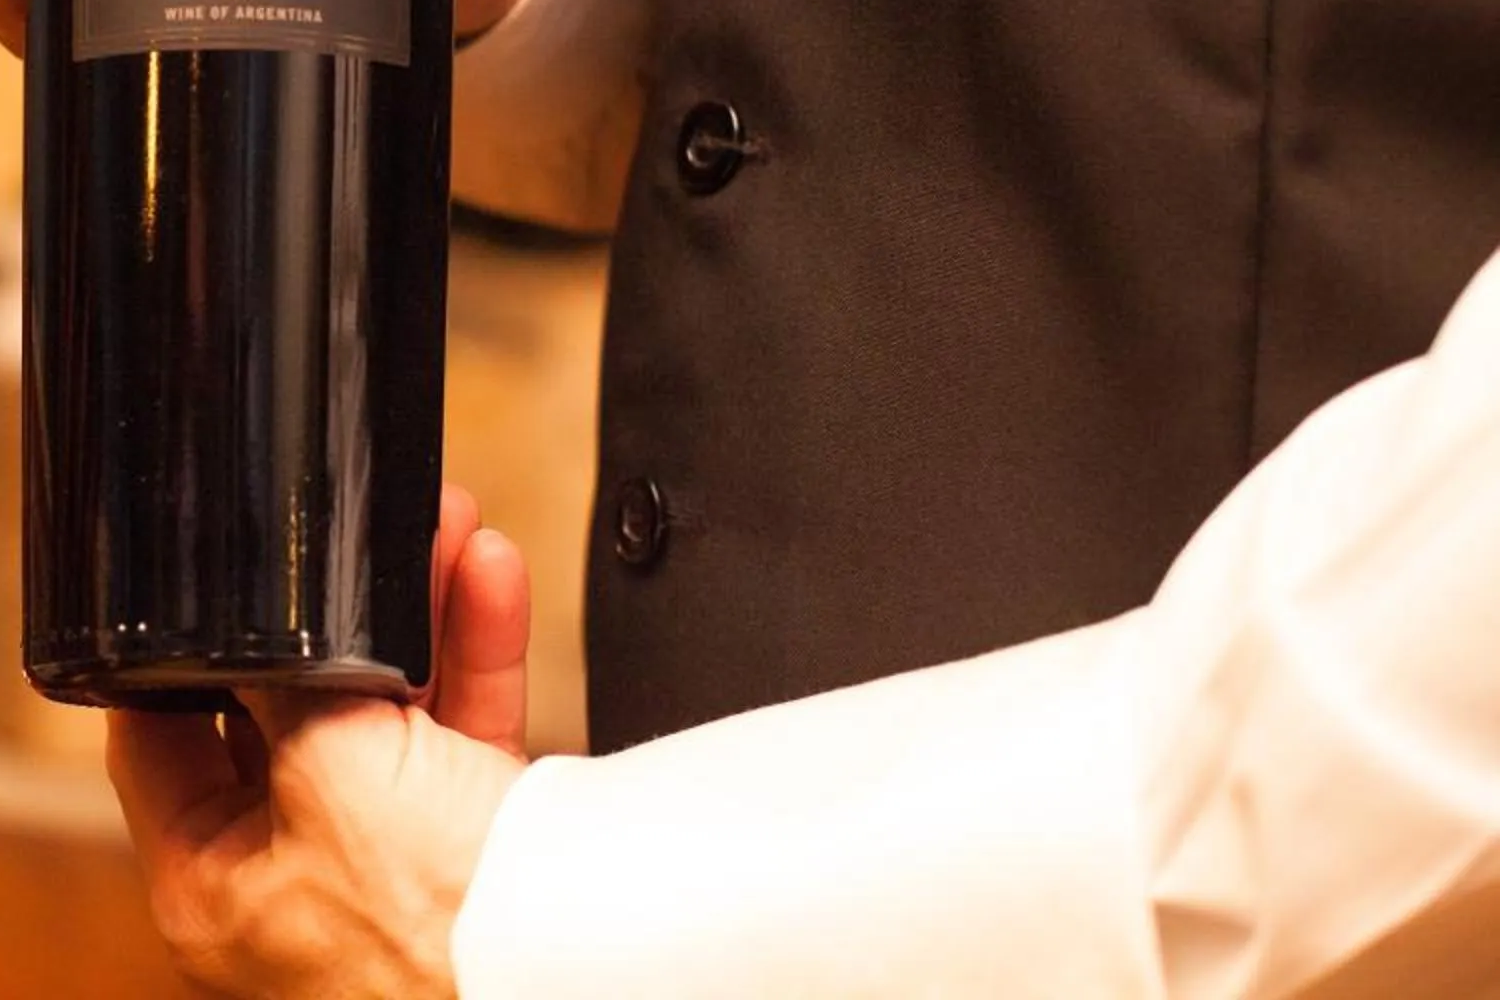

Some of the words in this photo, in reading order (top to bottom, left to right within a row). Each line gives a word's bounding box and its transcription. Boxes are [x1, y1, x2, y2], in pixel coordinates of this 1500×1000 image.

[164, 5, 204, 22] WINE
[209, 4, 230, 21] OF
[235, 5, 324, 23] ARGENTINA
